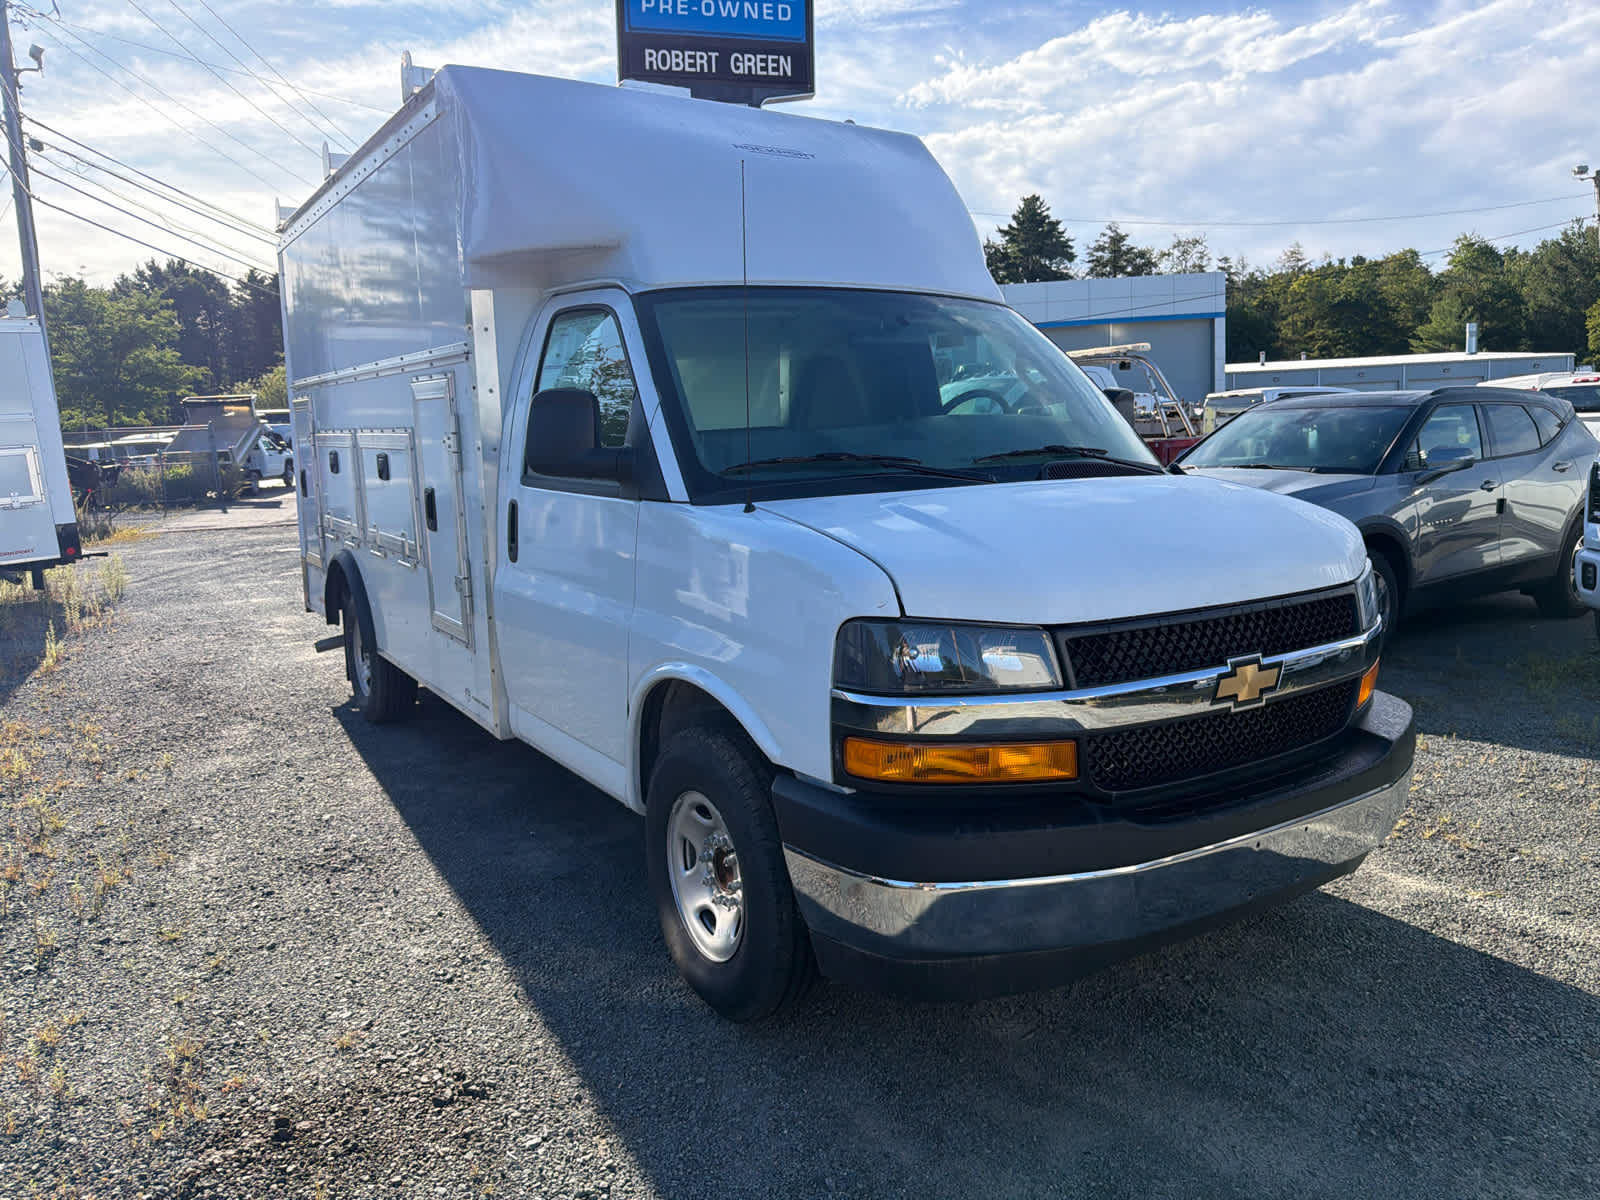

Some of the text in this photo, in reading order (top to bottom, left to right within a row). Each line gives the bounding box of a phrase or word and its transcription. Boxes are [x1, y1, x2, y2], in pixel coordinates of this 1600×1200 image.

[641, 0, 792, 21] PRE-OWNED
[644, 48, 792, 76] ROBERT GREEN
